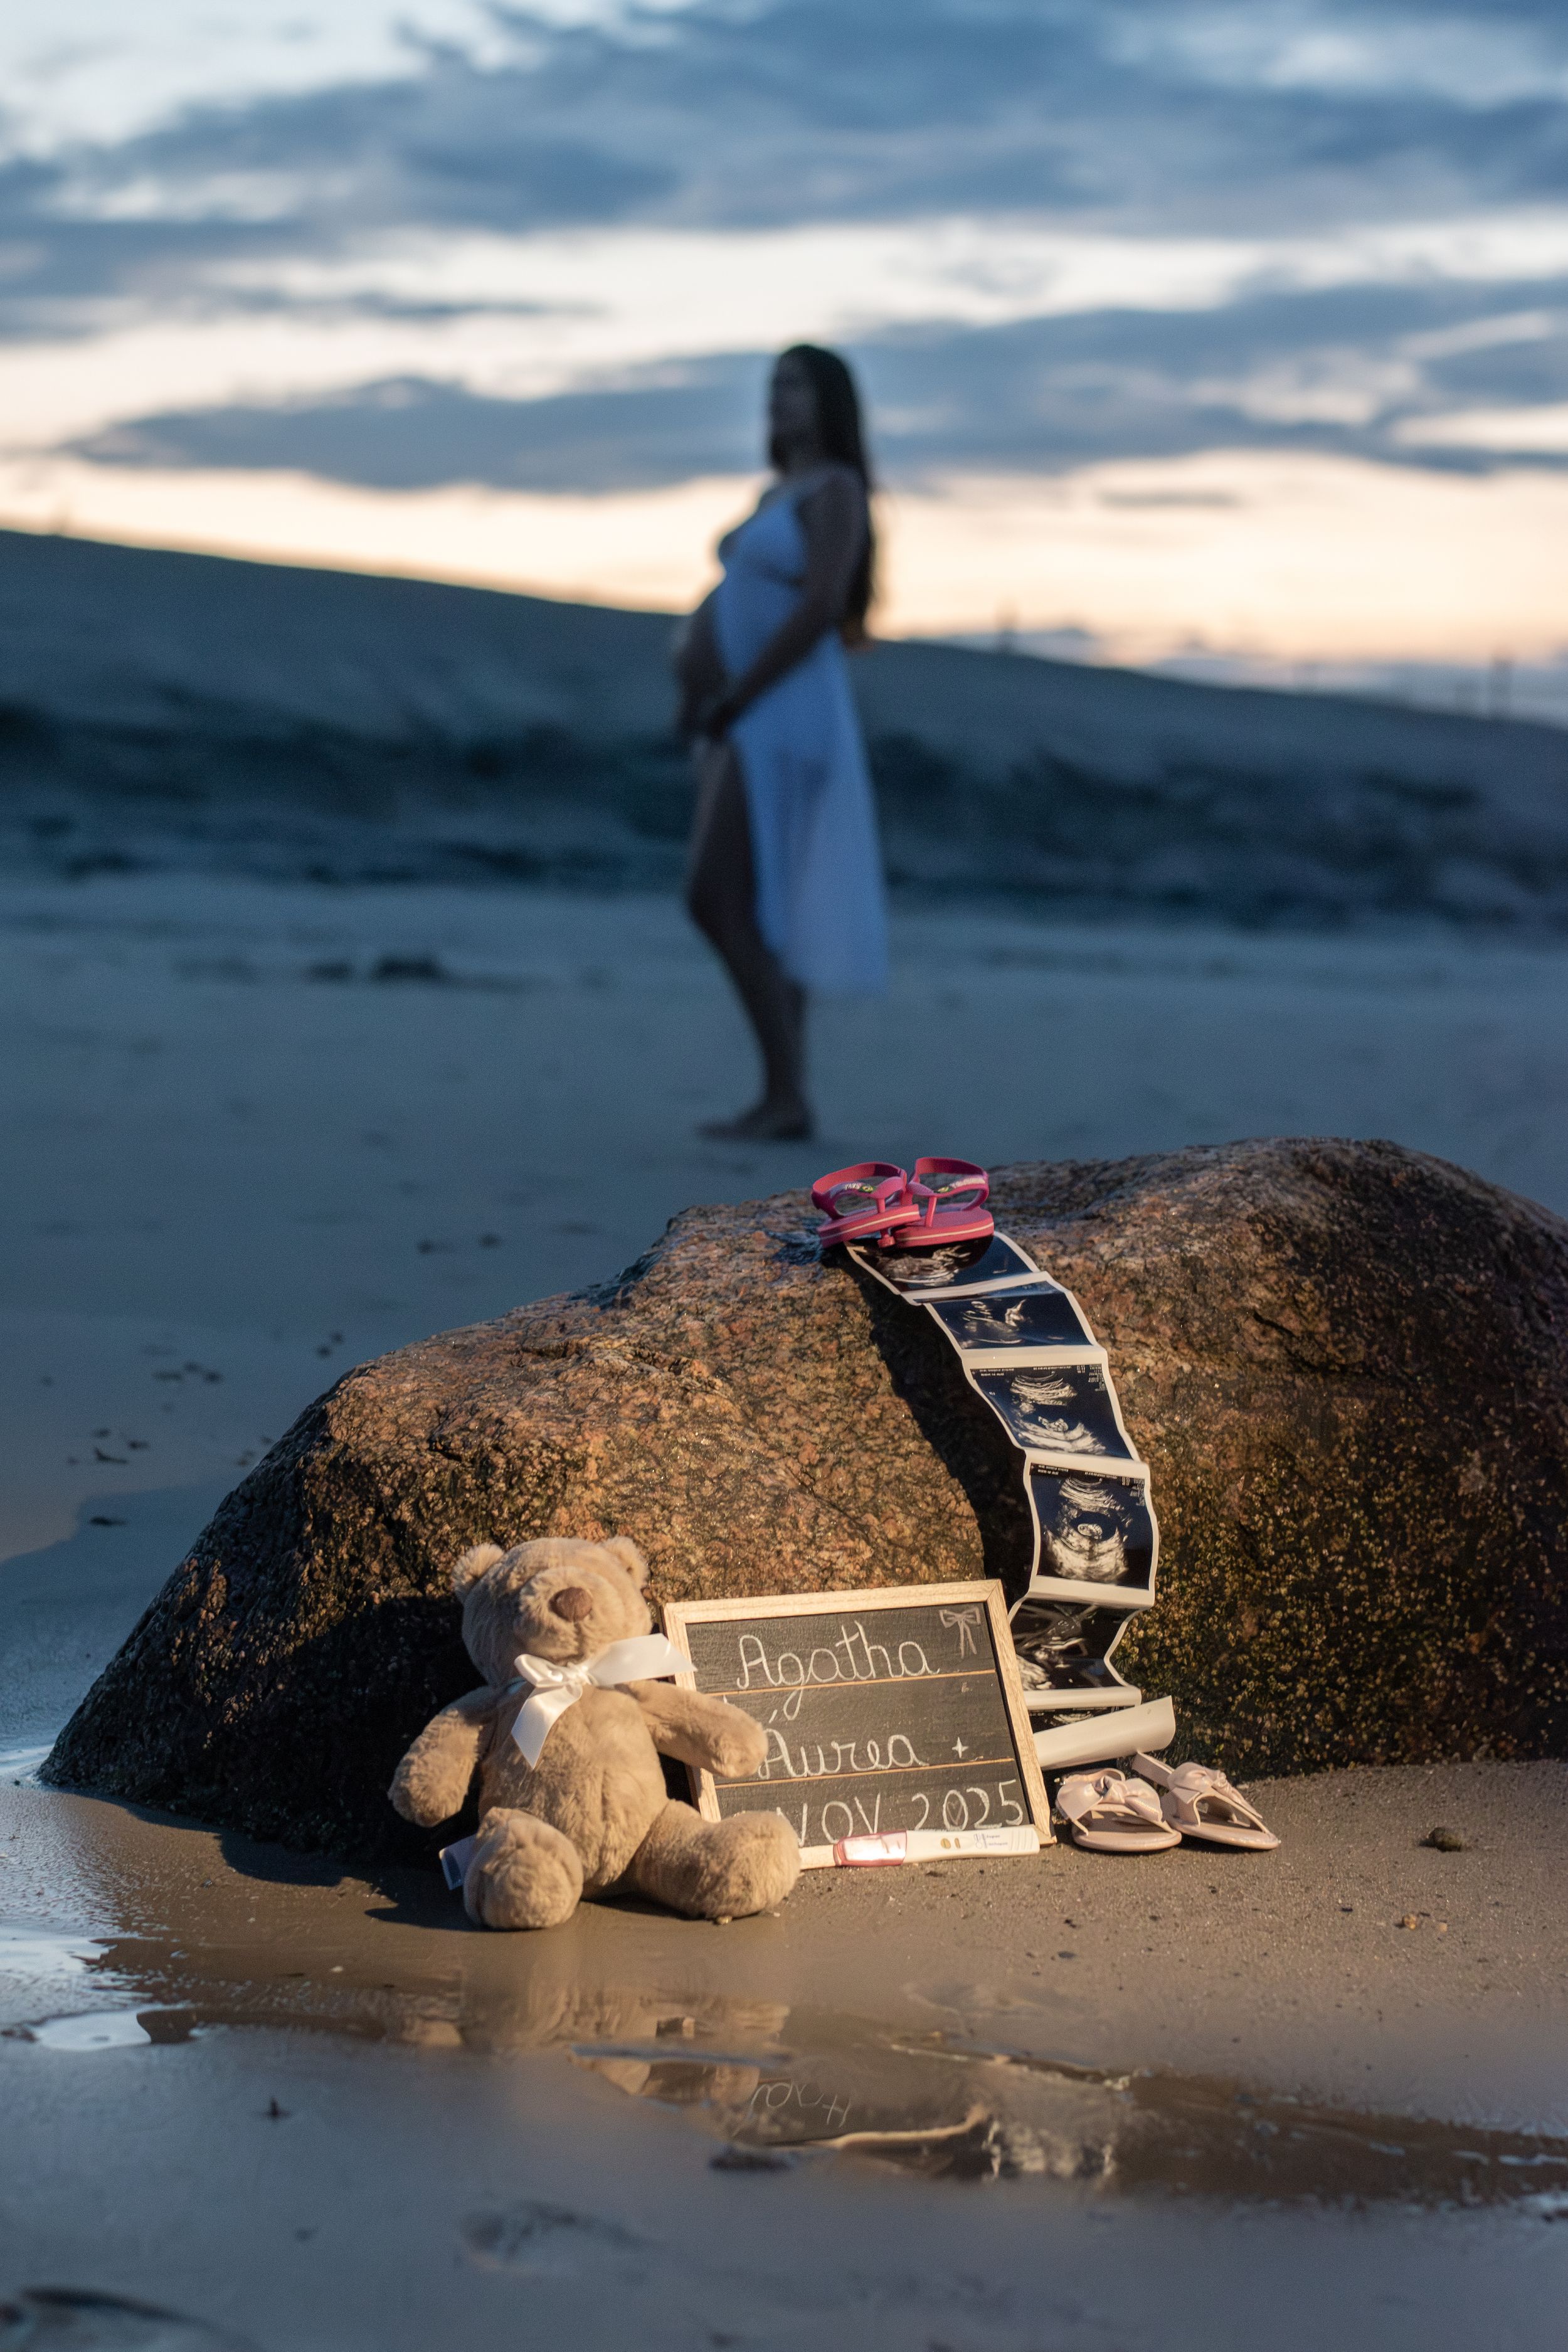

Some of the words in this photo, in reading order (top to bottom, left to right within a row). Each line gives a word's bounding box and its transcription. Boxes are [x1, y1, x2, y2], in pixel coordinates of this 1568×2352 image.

[736, 1621, 940, 1721] Agatha
[758, 1709, 930, 1779] Áurea
[912, 1779, 1023, 1831] 2025
